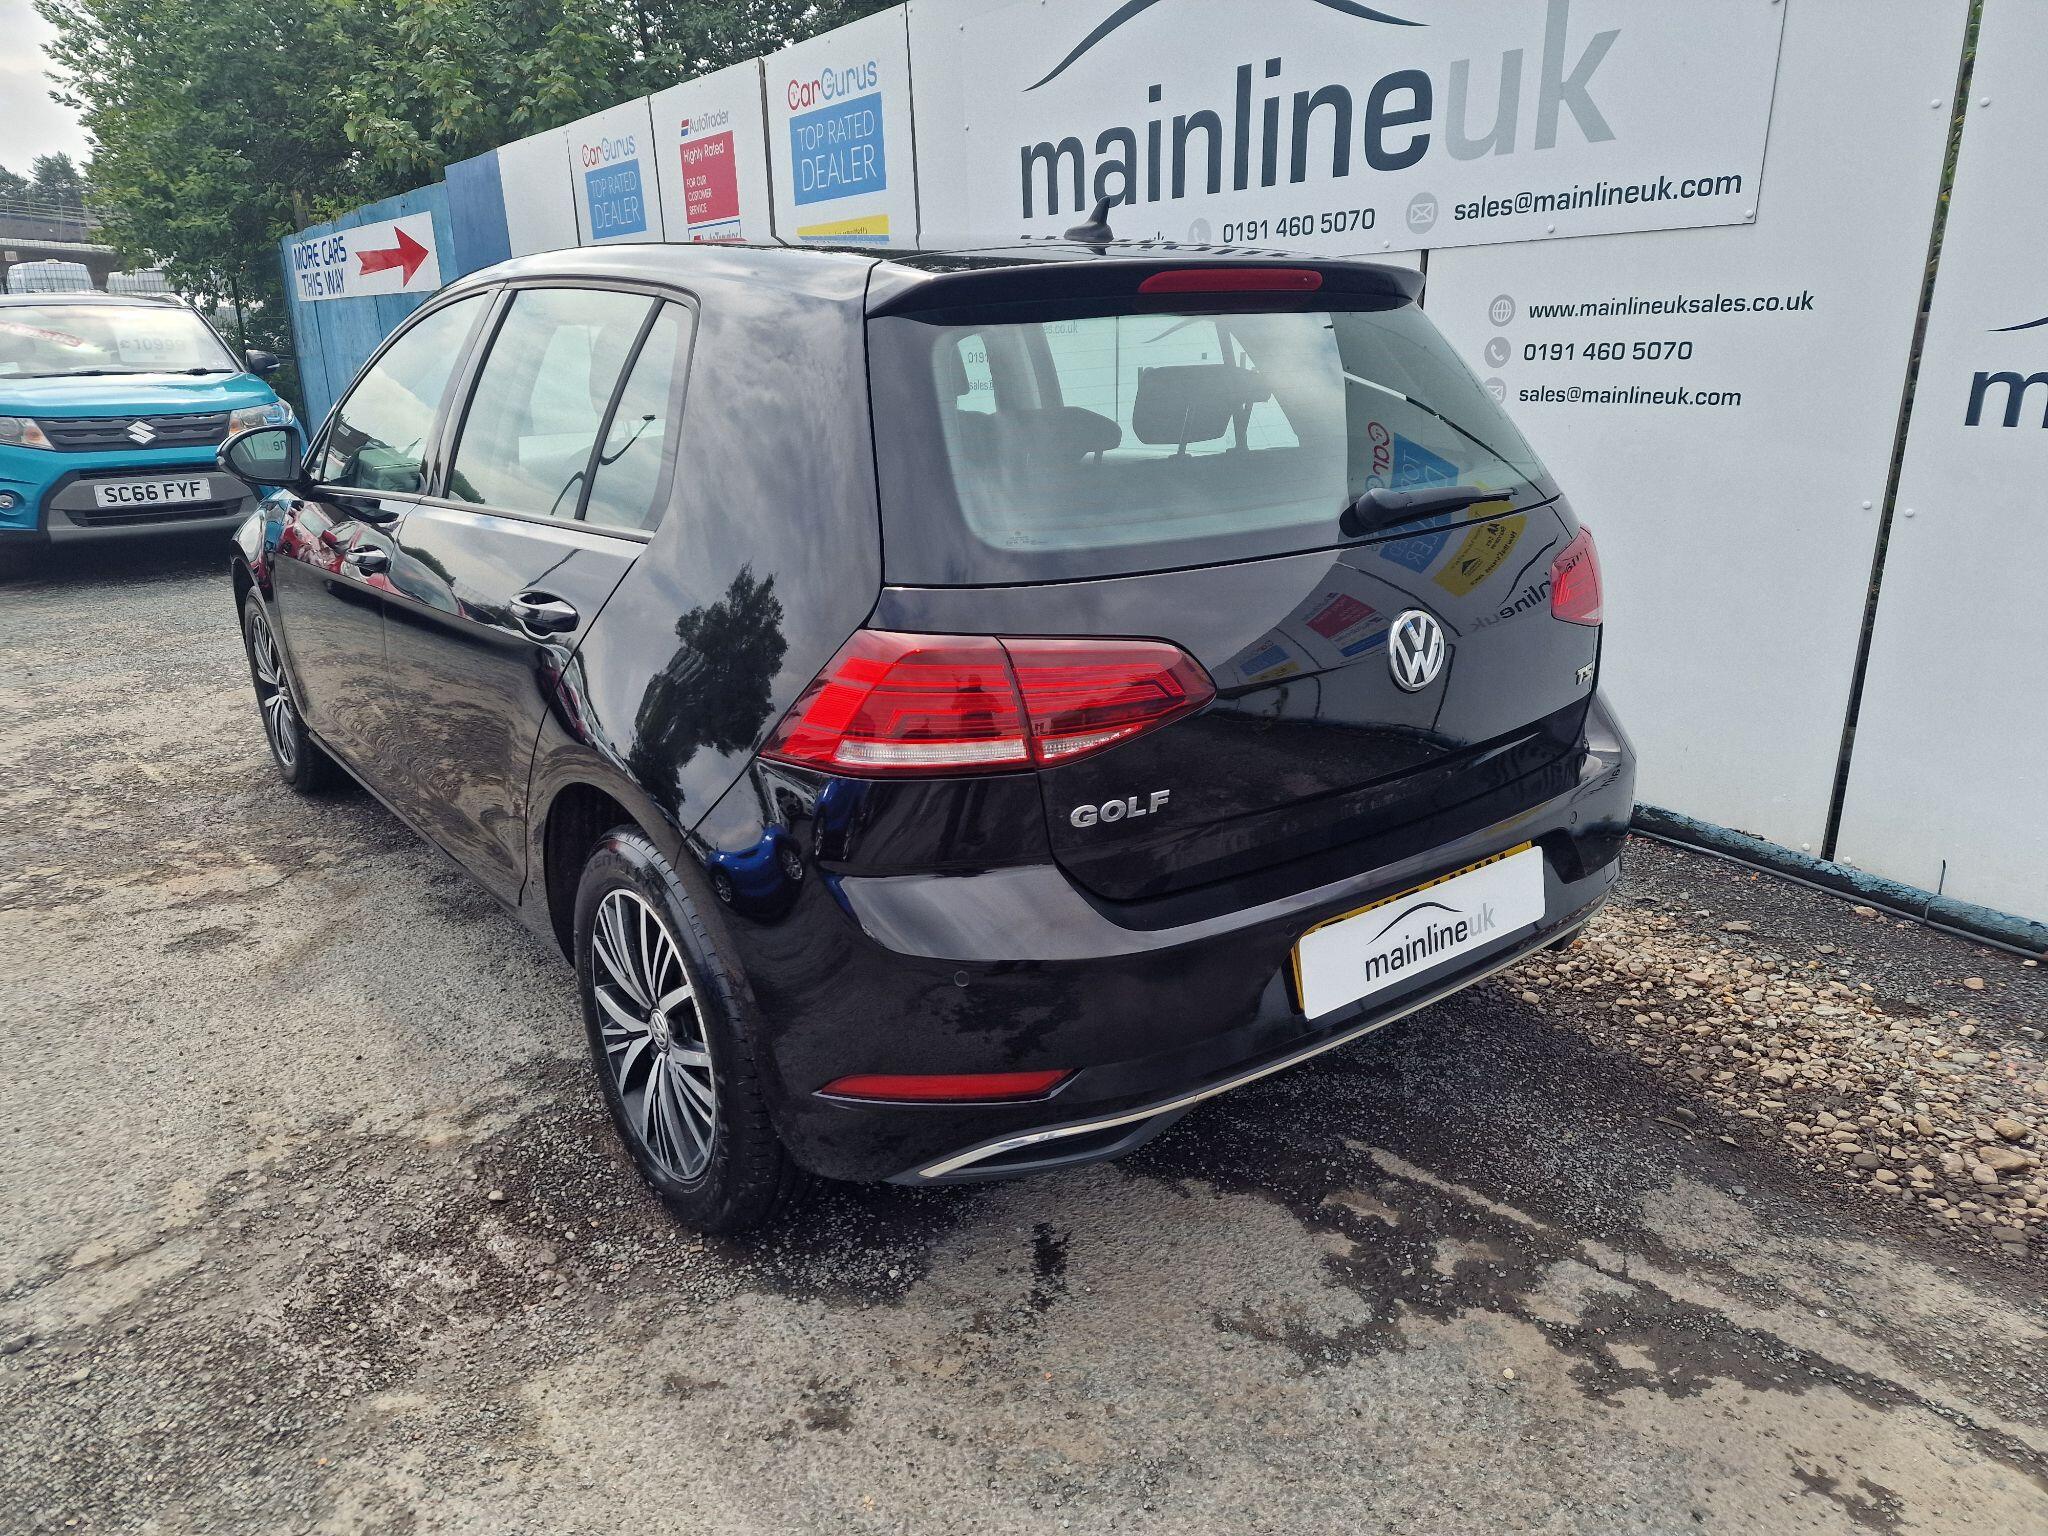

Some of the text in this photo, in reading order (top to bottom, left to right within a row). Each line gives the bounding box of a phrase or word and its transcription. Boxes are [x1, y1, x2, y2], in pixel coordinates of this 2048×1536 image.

[787, 60, 878, 111] CarGurus
[689, 109, 729, 135] AutoTrader
[1020, 0, 1621, 219] mainlineuk
[797, 109, 875, 151] TOP RATED
[582, 135, 636, 167] CarGurus
[683, 140, 724, 164] Highly Rated
[801, 143, 877, 192] DEALER
[590, 171, 637, 198] TOP RATED
[1454, 173, 1743, 222] sales@mainlineuk.com
[594, 196, 641, 229] DEALER
[1223, 207, 1376, 243] 0191 460 5070
[293, 235, 347, 271] MORE CARS
[301, 268, 345, 297] THIS WAY
[1528, 290, 1814, 318] www.mainlineuksales.co.uk
[1523, 341, 1693, 361] 0191 460 5070
[1518, 384, 1742, 407] sales@mainlineuk.com
[104, 481, 200, 503] SC66 FYF
[1070, 789, 1170, 828] GOLF
[1364, 902, 1496, 982] mainlineuk
